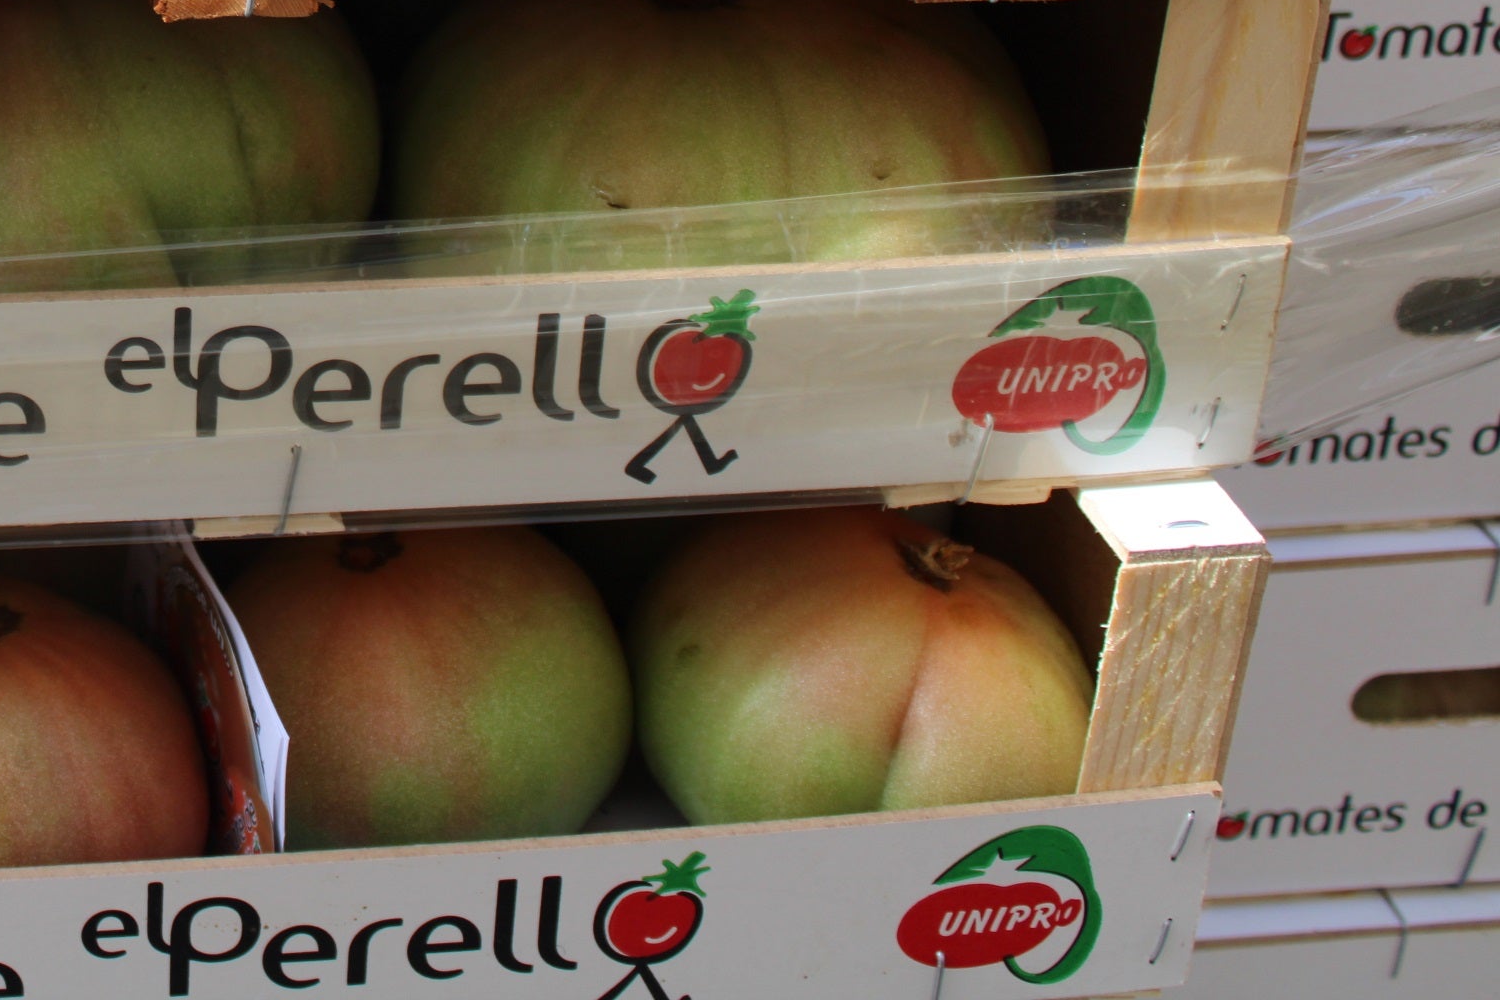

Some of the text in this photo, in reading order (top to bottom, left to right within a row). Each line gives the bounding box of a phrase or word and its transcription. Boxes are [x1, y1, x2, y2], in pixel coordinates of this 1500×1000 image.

[997, 357, 1147, 395] UNIPRO
[1427, 789, 1488, 830] de
[938, 899, 1082, 937] UNIPRO
